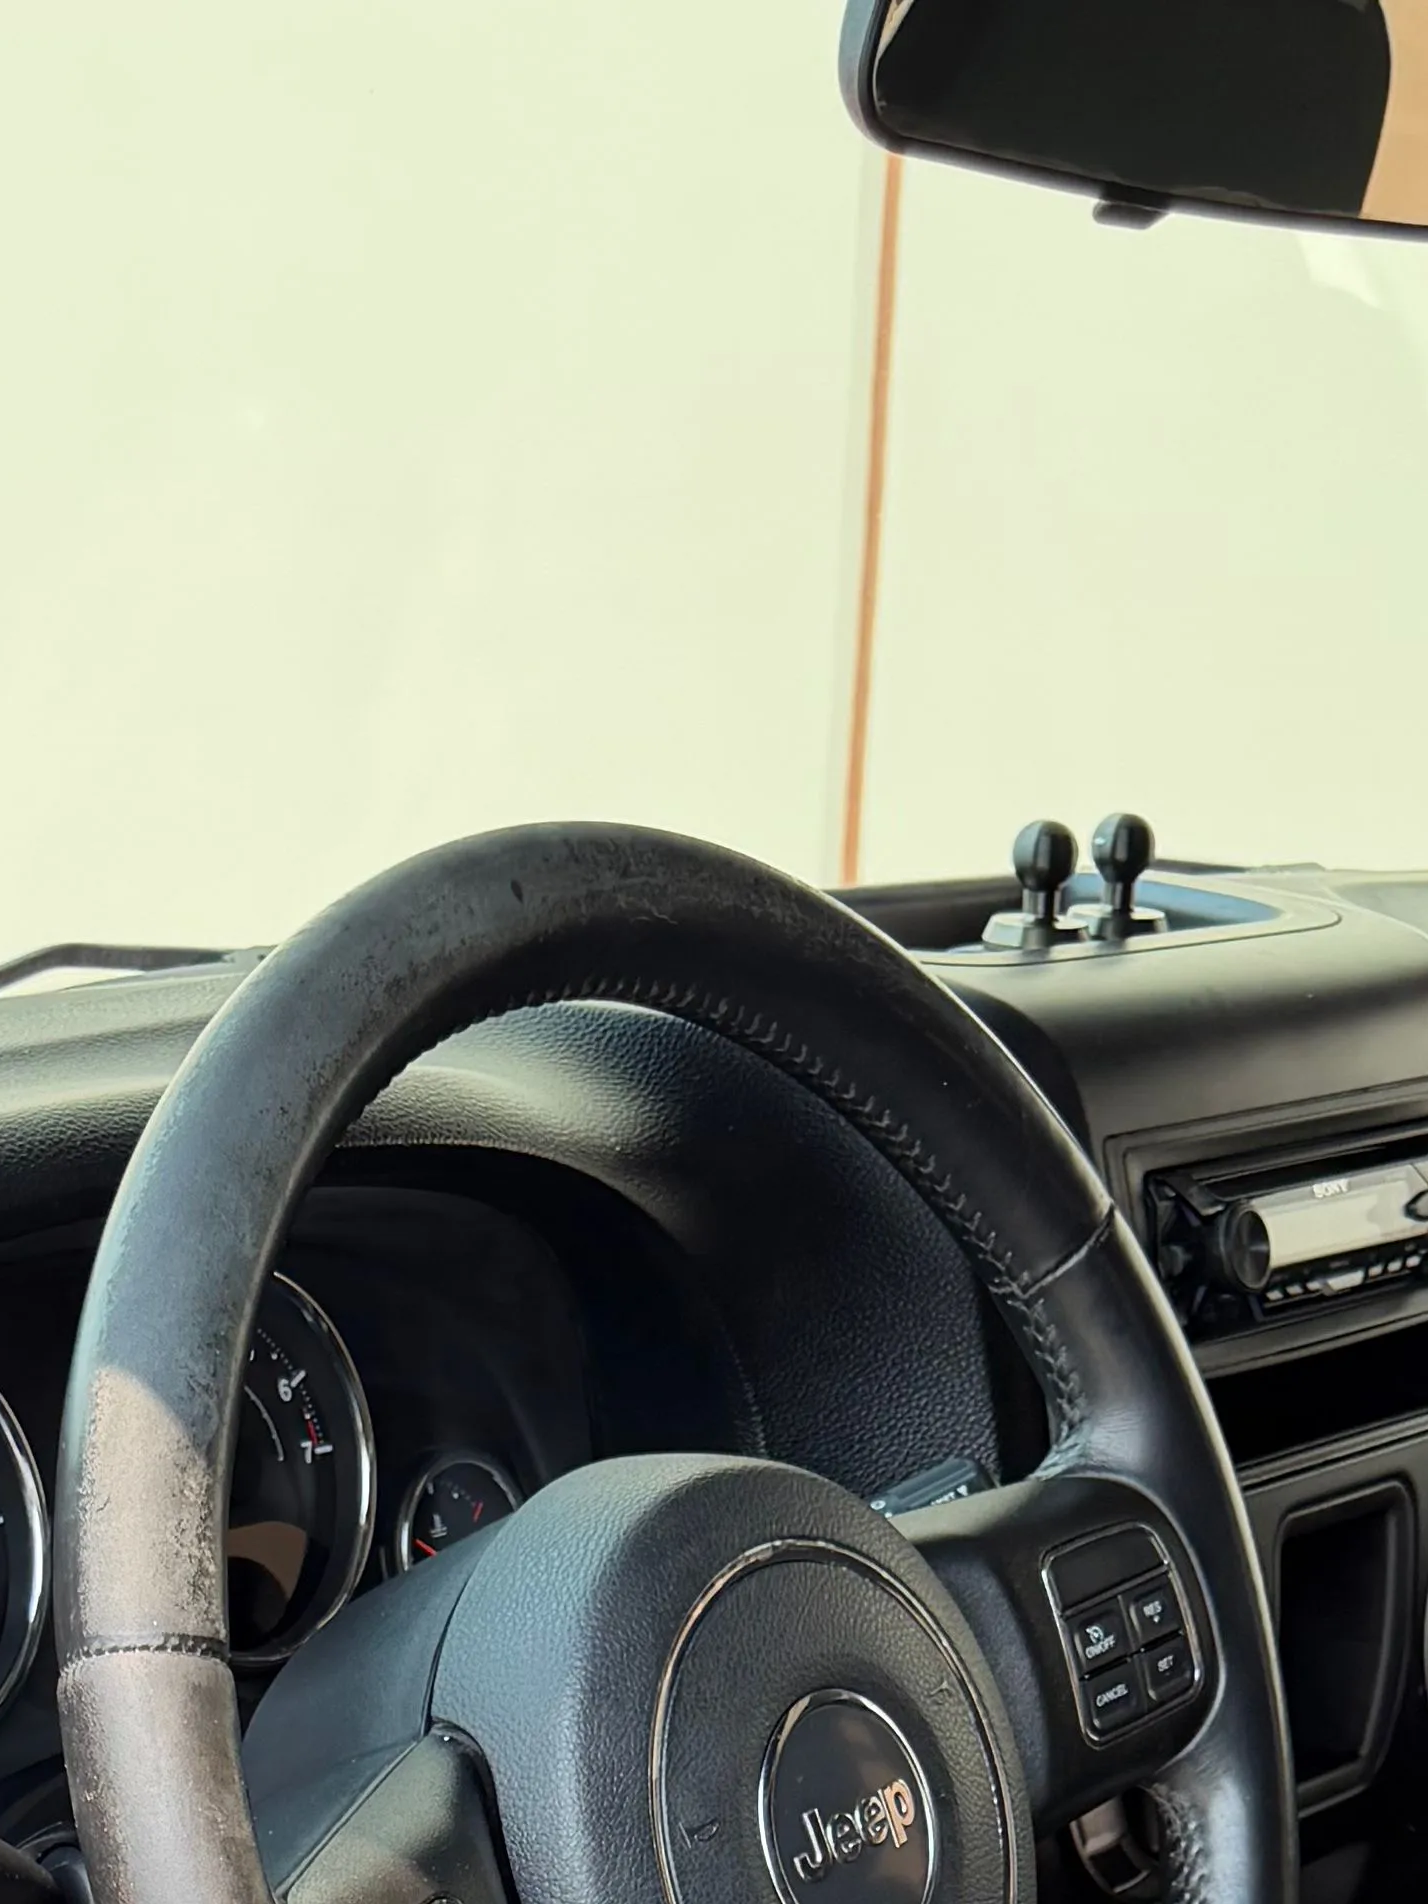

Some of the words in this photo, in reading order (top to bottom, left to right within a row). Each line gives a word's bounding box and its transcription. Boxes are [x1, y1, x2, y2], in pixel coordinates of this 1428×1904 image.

[277, 1377, 293, 1402] 6
[300, 1440, 312, 1464] 7
[1096, 1683, 1129, 1708] CANCEL
[793, 1778, 915, 1884] Jeep
